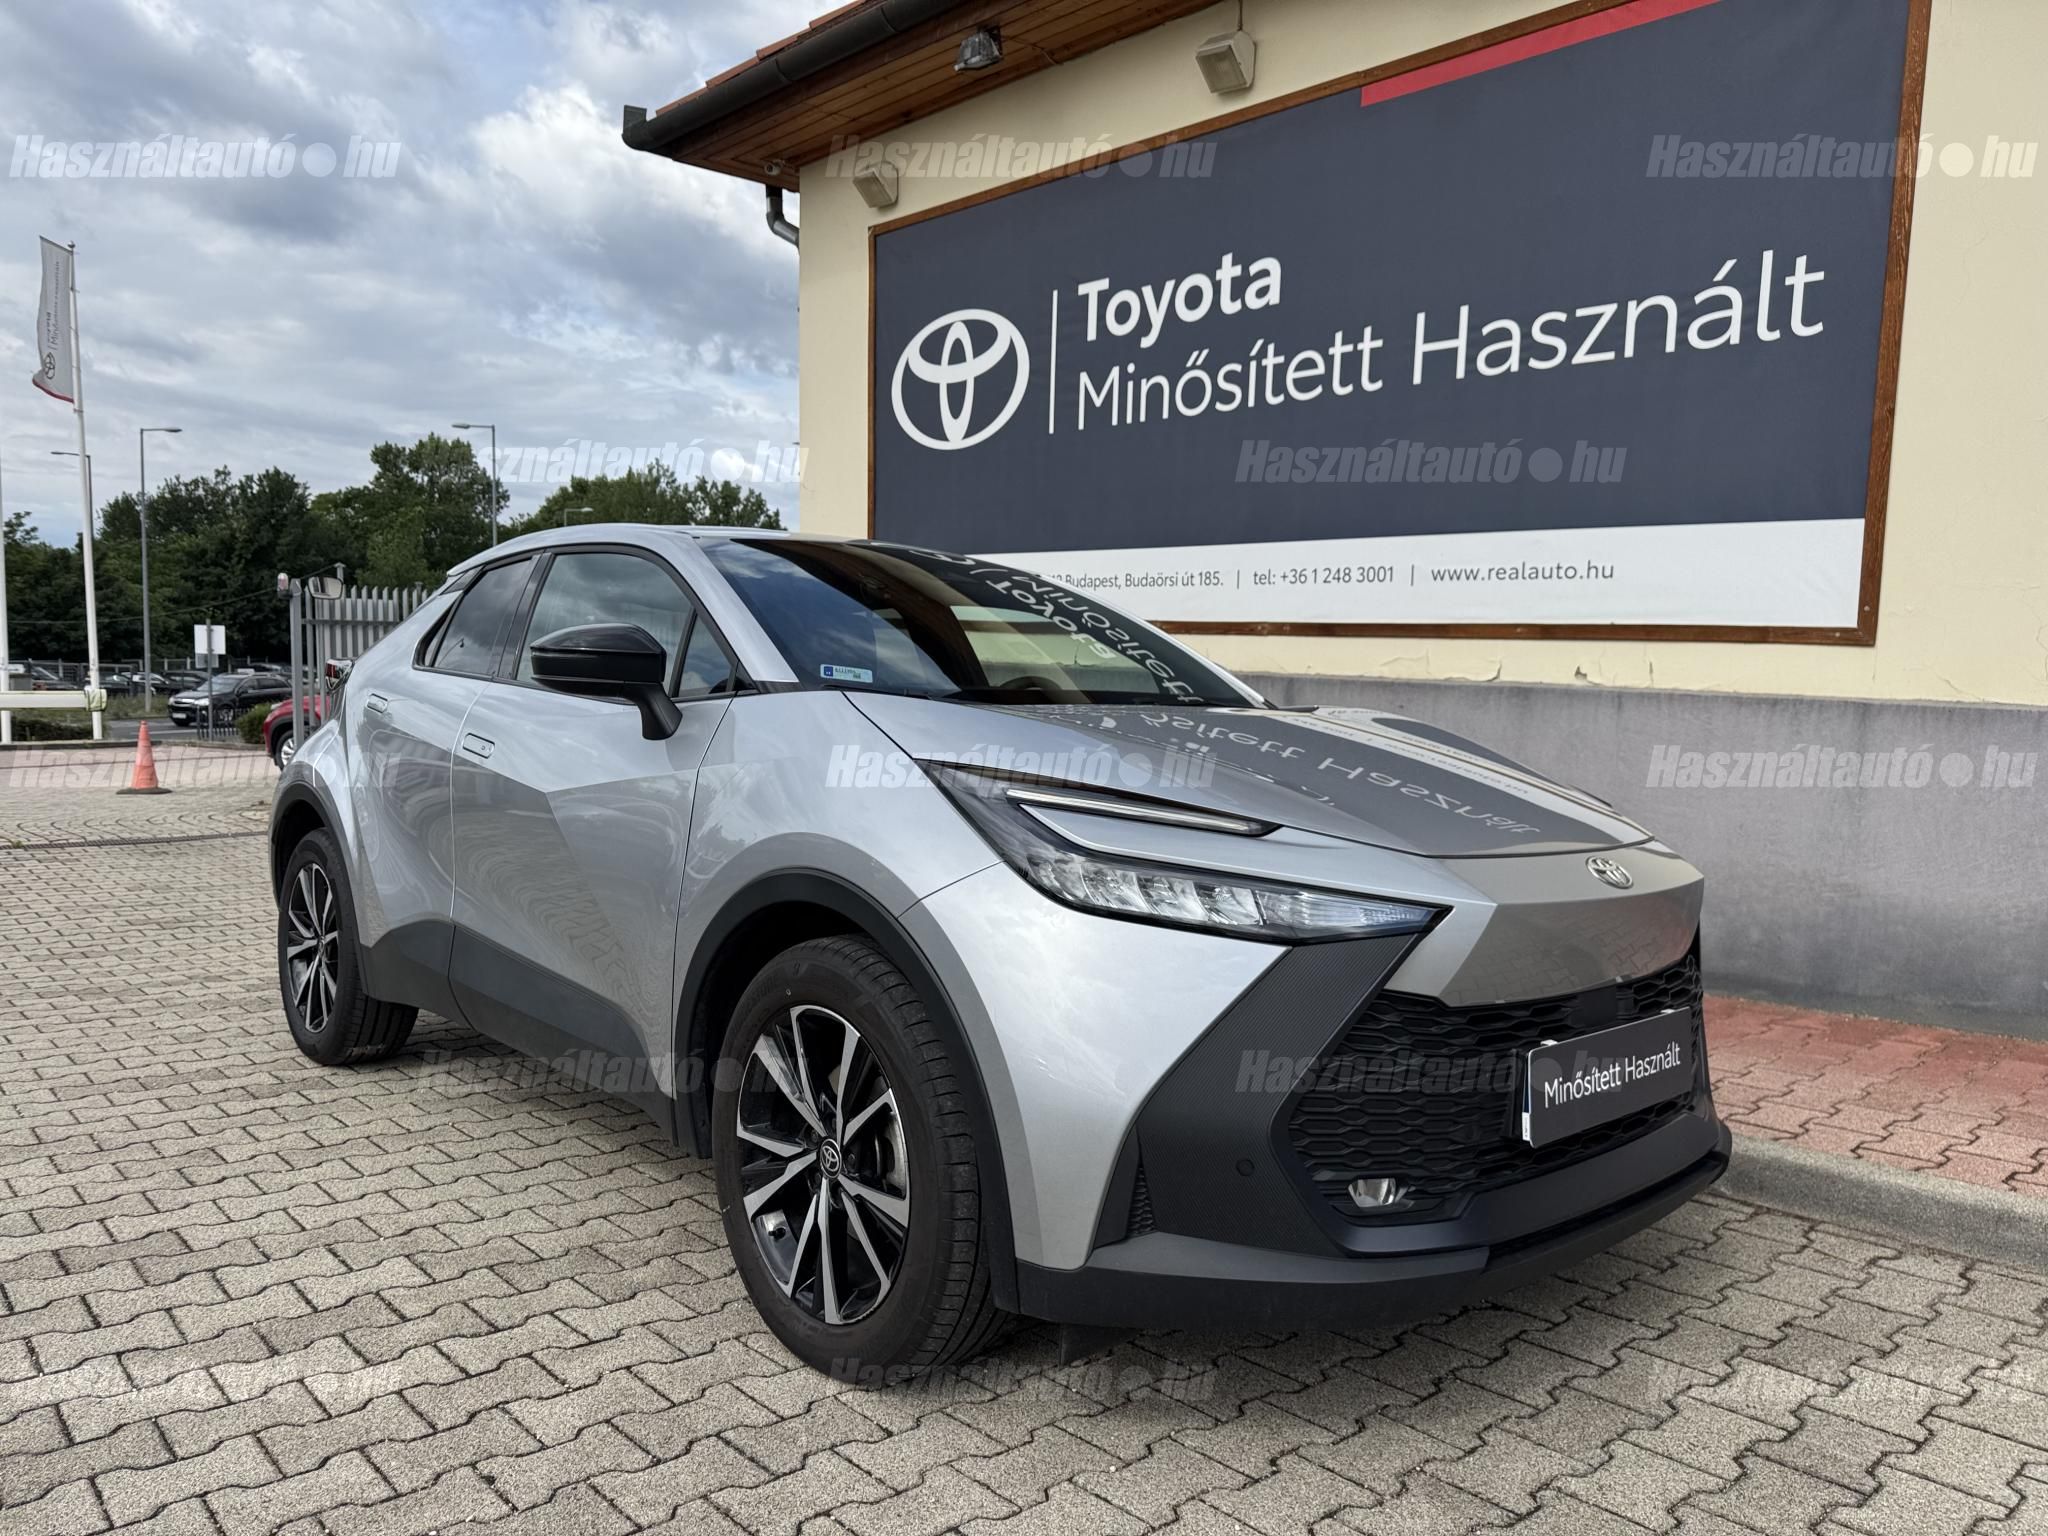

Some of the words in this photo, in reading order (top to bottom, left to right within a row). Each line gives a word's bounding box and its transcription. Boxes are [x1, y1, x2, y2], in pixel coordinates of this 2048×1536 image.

[1078, 252, 1283, 349] Toyota
[1079, 325, 1384, 431] Minősített
[1413, 249, 1826, 386] Használt
[1124, 571, 1179, 587] Budaörsi
[1181, 571, 1195, 587] út
[1198, 571, 1223, 586] 185.
[1253, 568, 1277, 585] tel:
[1322, 567, 1352, 584] 248
[1356, 566, 1393, 583] 3001
[1431, 560, 1616, 582] www.realauto.hu
[1544, 1060, 1622, 1109] Minősített
[1624, 1040, 1682, 1083] Használt
